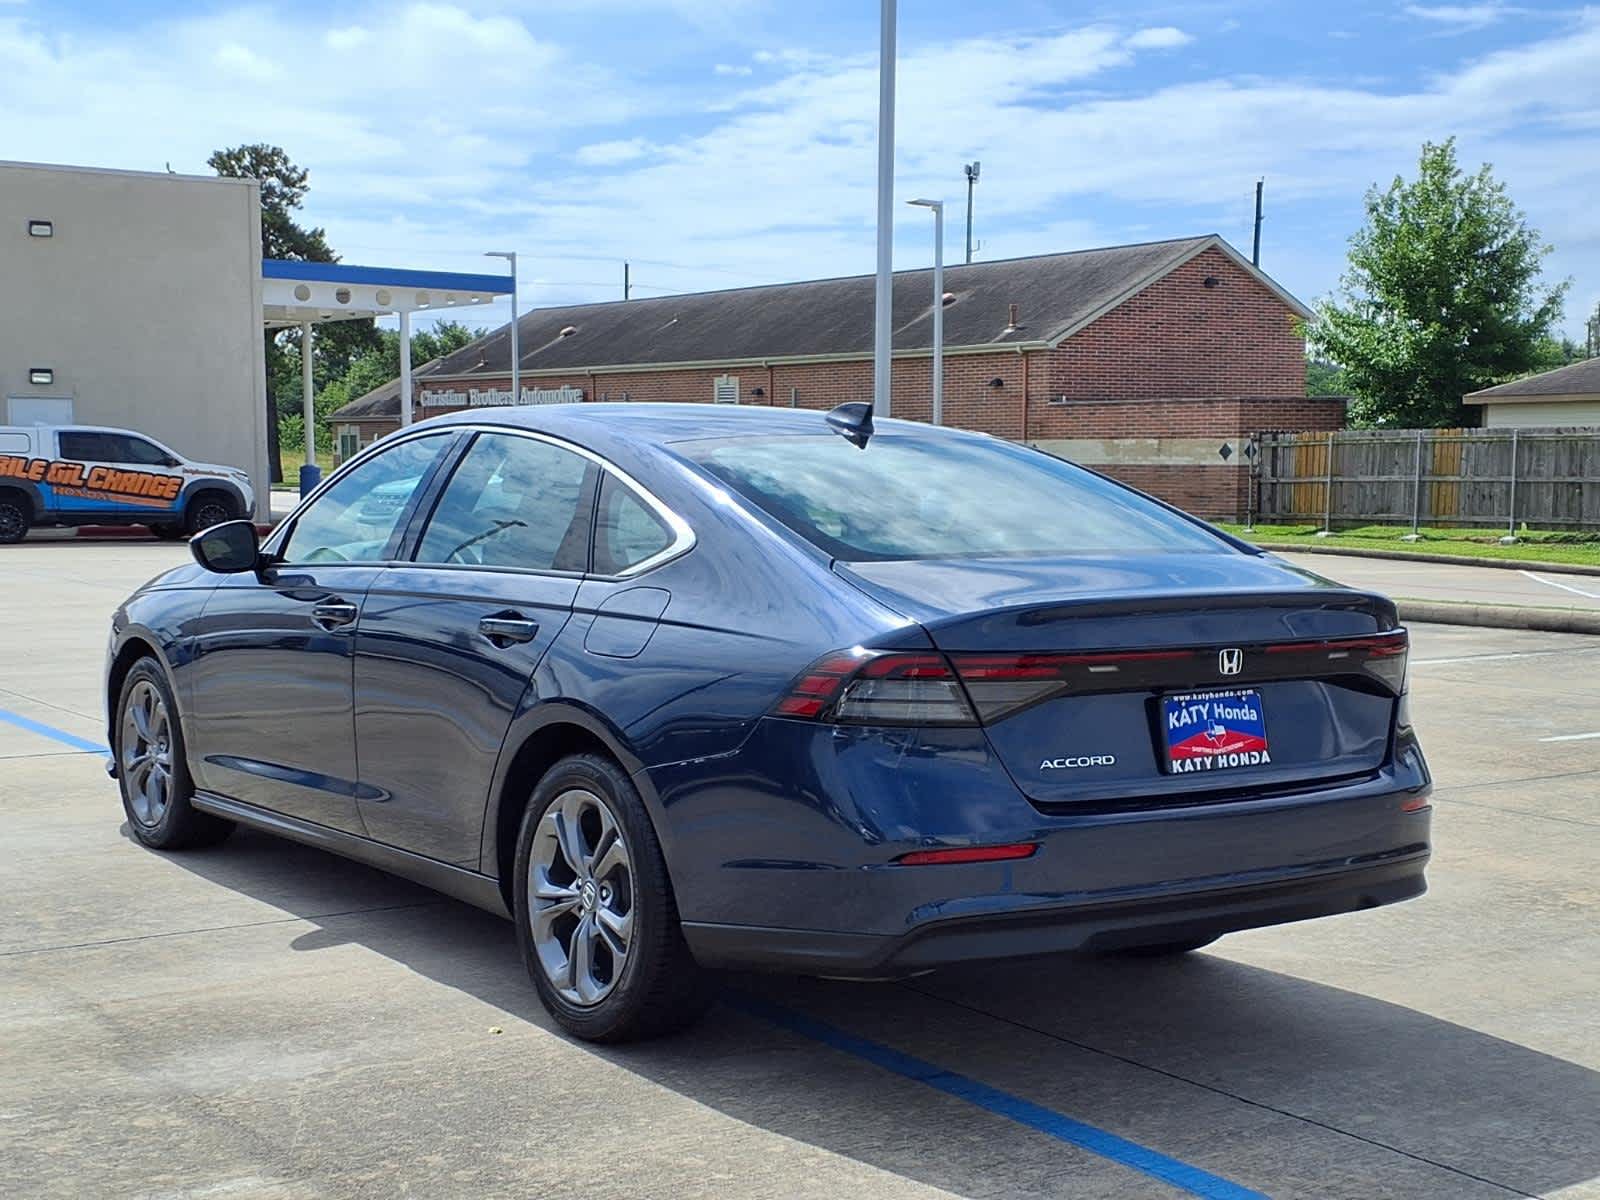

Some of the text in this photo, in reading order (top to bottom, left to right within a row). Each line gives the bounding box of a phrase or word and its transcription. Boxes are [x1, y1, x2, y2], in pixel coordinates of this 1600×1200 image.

[420, 385, 584, 406] Christian Brothers Automotive
[88, 467, 182, 499] CHANGE
[1173, 689, 1254, 702] www.katyhonda.com
[1168, 702, 1258, 730] KATY Honda
[1040, 755, 1115, 769] ACCORD
[1172, 750, 1271, 774] KATY HONDA
